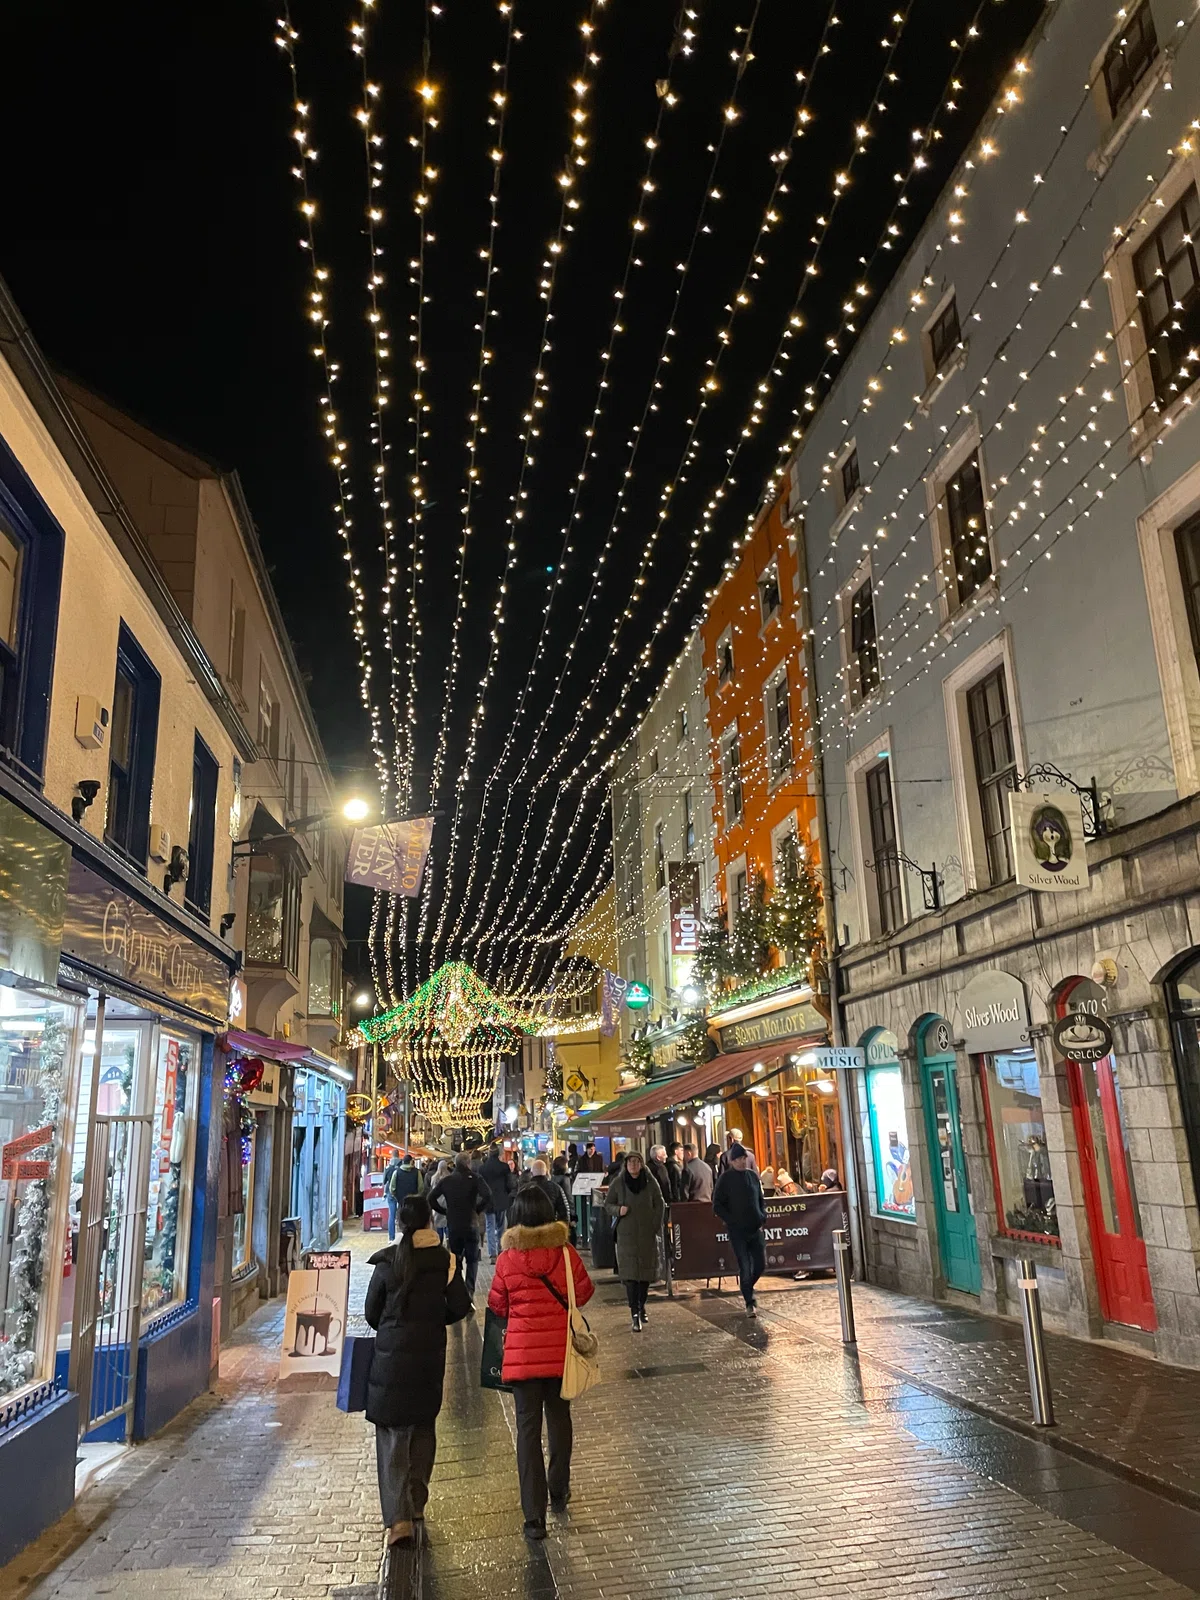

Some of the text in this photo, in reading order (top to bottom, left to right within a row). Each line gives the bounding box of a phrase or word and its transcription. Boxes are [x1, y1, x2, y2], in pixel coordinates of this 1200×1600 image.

[402, 818, 425, 889] OME TO
[1028, 873, 1080, 886] Silver Wood
[102, 900, 168, 979] GALWAY
[965, 997, 1019, 1029] Silver Wood
[735, 1024, 762, 1045] SONNY
[761, 1012, 806, 1039] MOLLOY'S
[817, 1055, 861, 1067] MUSIC
[870, 1044, 894, 1060] OPUS
[160, 1043, 177, 1170] SALE
[764, 1203, 807, 1214] OLLOY'S
[715, 1227, 809, 1242] TH NT DOOR
